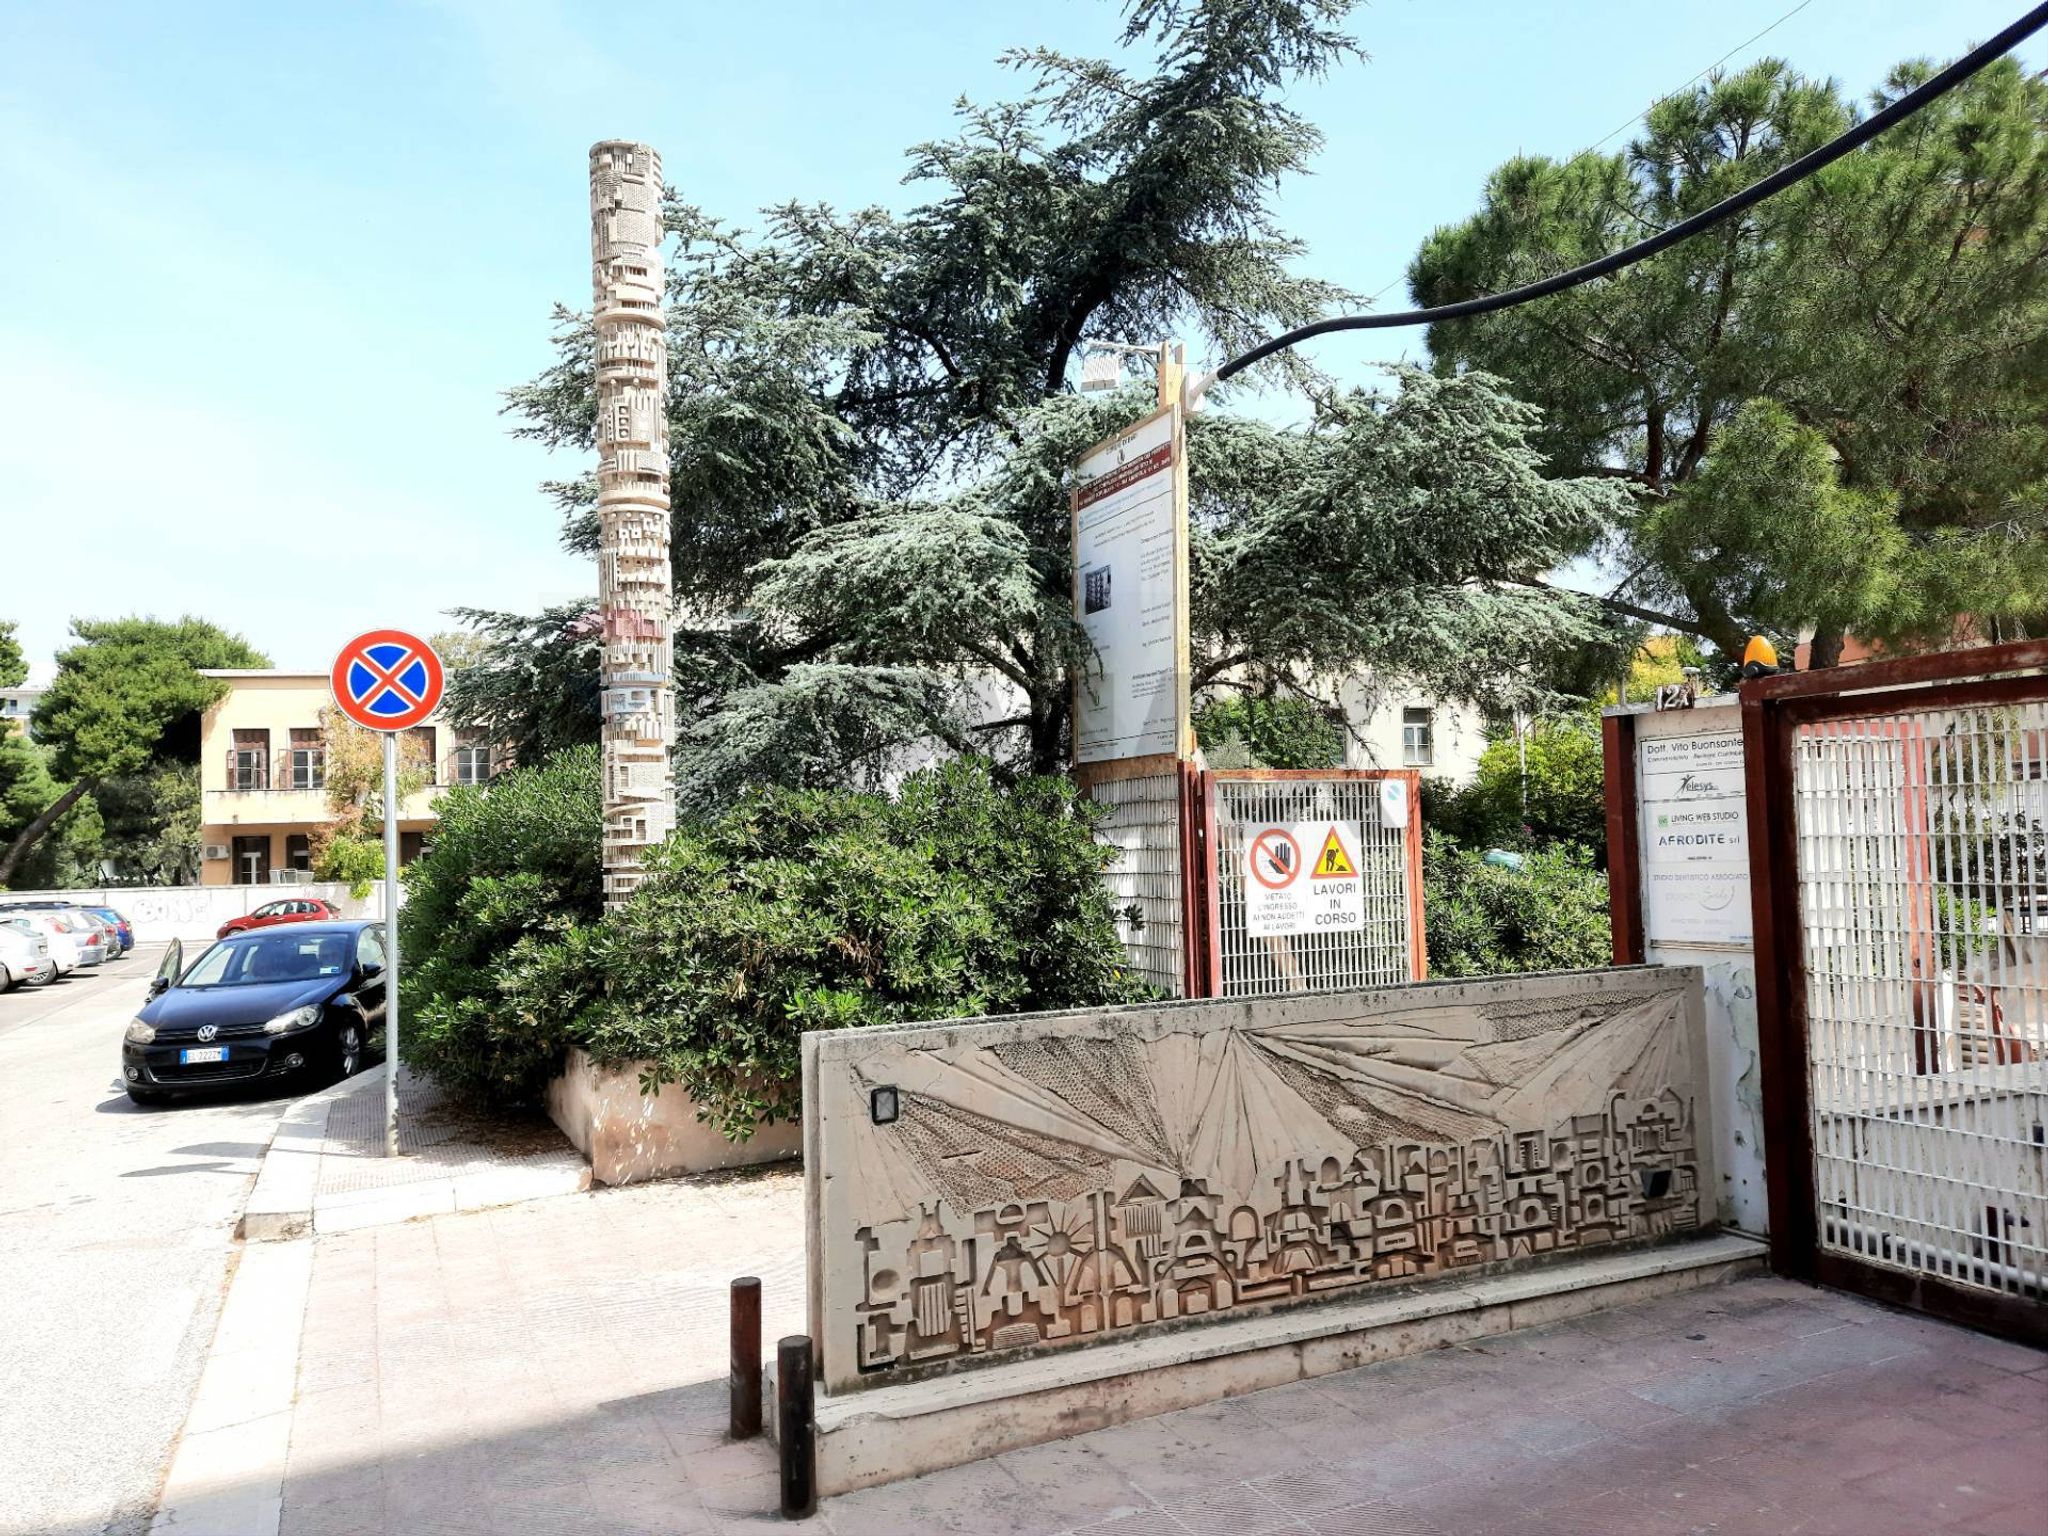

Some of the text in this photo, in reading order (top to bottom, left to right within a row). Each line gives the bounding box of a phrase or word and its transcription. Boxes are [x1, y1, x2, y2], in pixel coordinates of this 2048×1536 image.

[1671, 743, 1689, 752] Vito
[1691, 738, 1744, 750] Buonsante
[1671, 813, 1694, 823] LIVING
[1696, 812, 1711, 821] WEB
[1713, 811, 1739, 820] STUDIO
[1659, 833, 1725, 846] AFRODITE
[1313, 883, 1356, 895] LAVORI
[1264, 892, 1292, 900] VETATO
[1329, 899, 1341, 909] IN
[1315, 912, 1357, 925] CORSO
